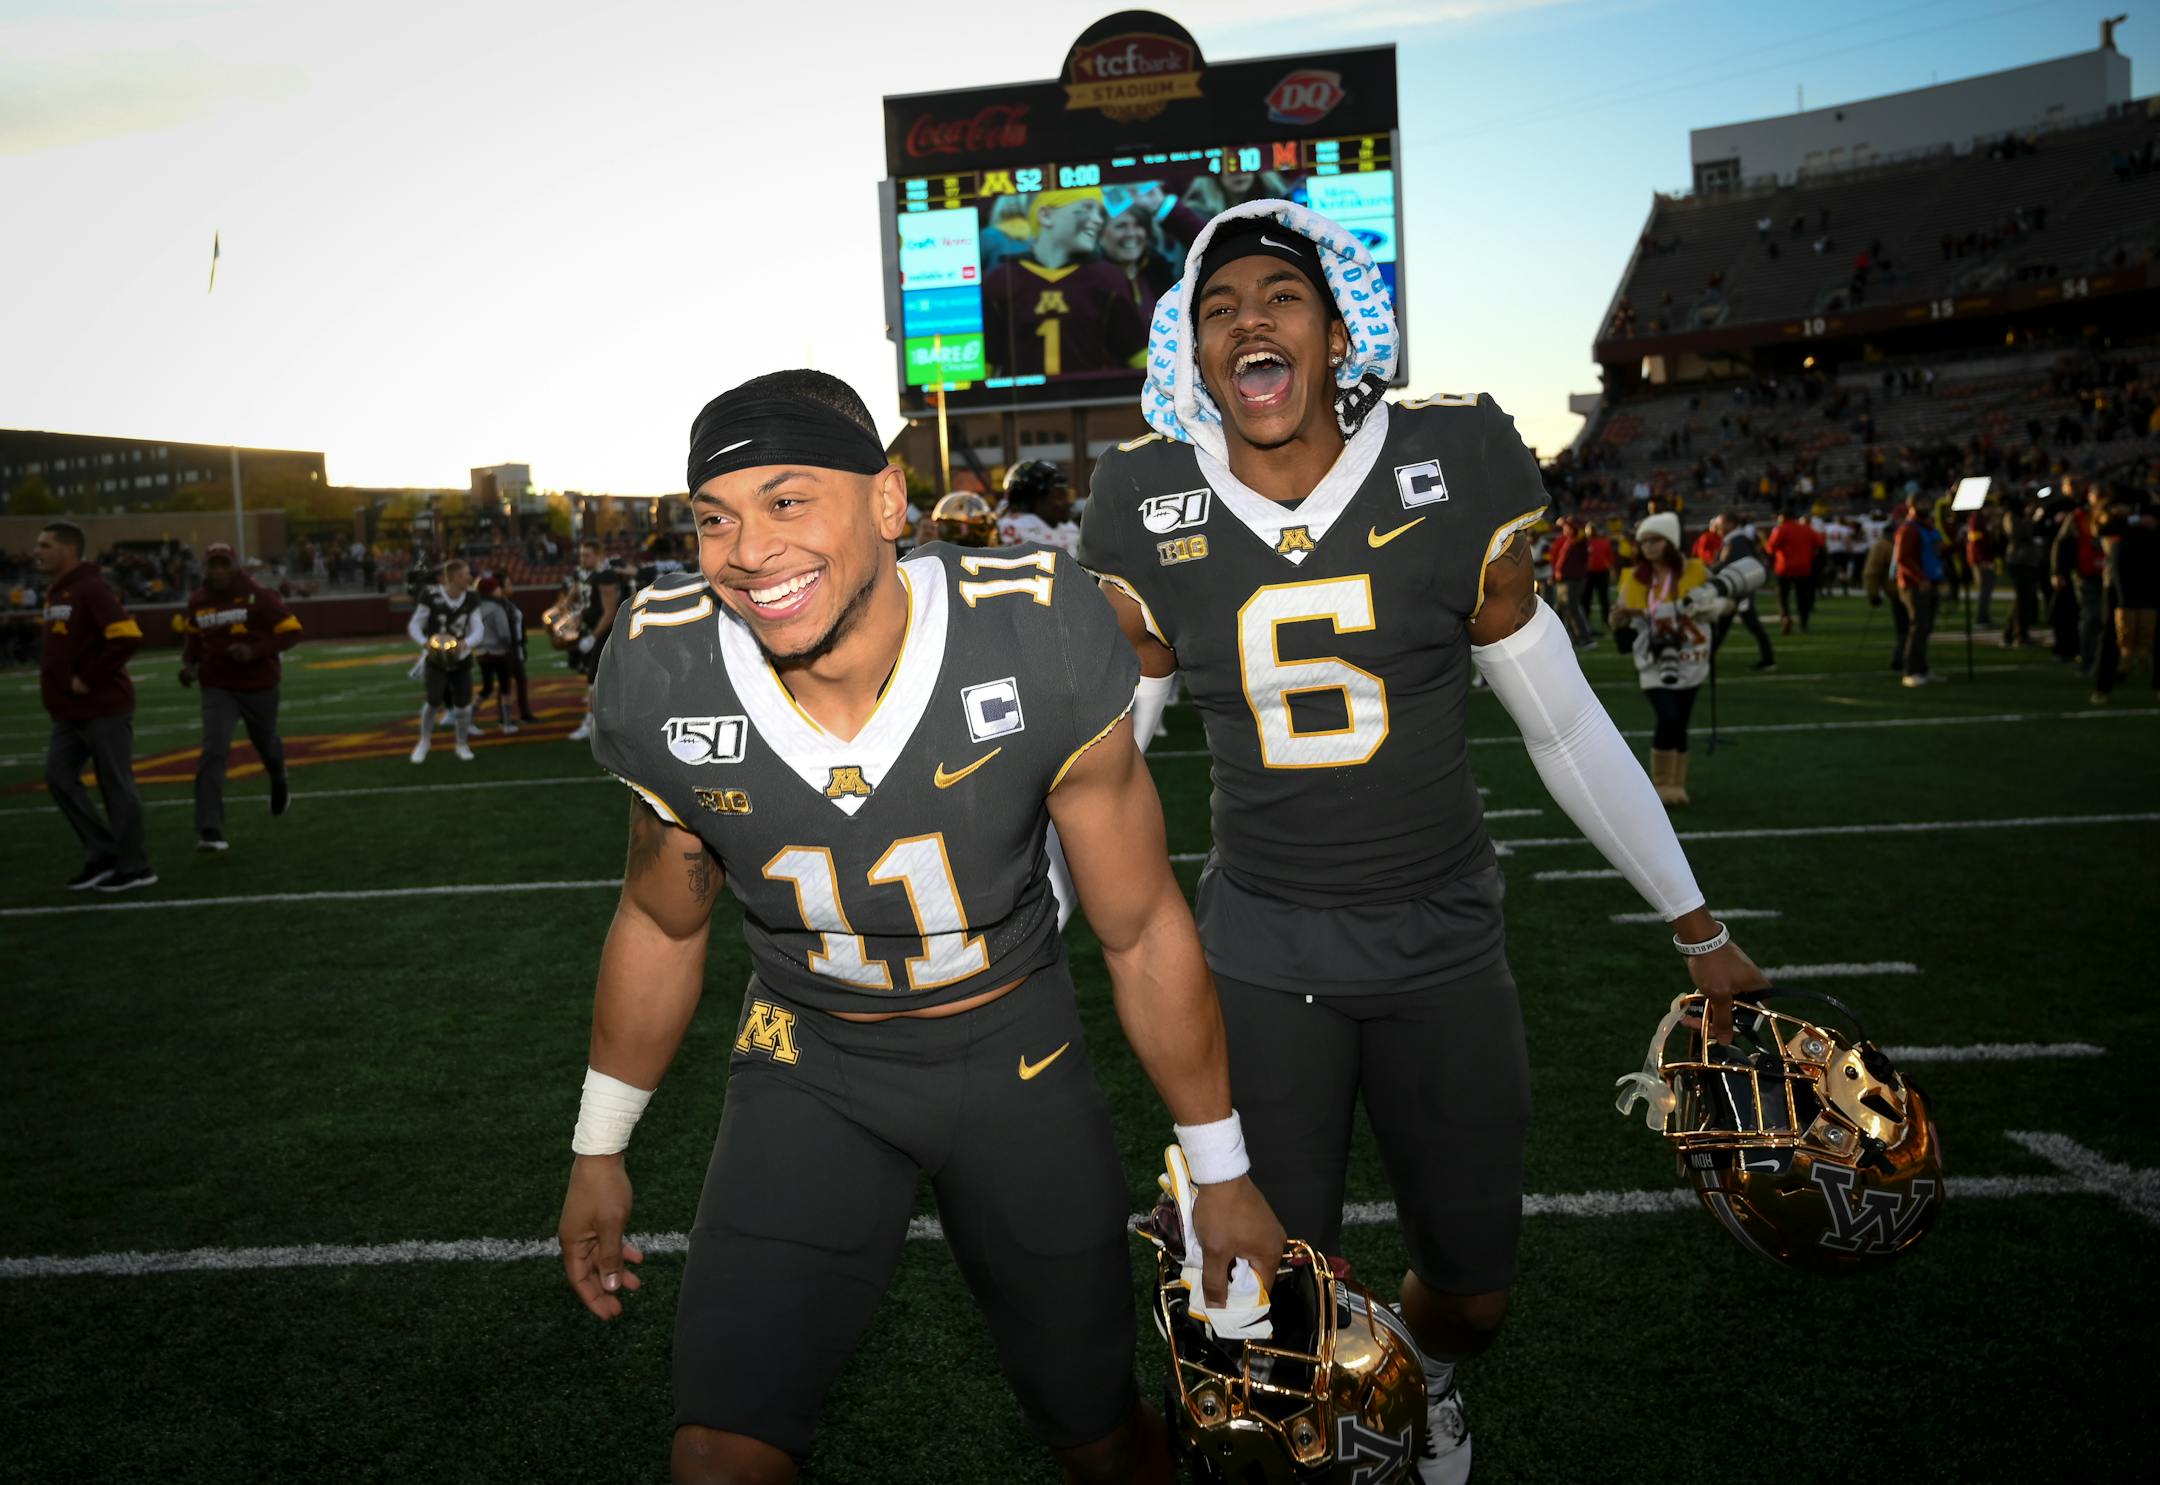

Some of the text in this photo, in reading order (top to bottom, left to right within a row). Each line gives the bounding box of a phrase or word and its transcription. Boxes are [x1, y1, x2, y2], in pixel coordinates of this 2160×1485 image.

[1093, 82, 1174, 101] STADIUM
[1280, 81, 1332, 112] DQ
[1014, 167, 1043, 193] 52
[1036, 318, 1062, 376] 1
[1803, 317, 1827, 336] 10
[1398, 461, 1446, 508] C
[1138, 487, 1212, 534] 150
[1275, 525, 1318, 555] M
[959, 549, 1058, 608] 11
[1237, 573, 1390, 770] 6
[965, 680, 1020, 740] C
[661, 715, 748, 765] 150
[823, 765, 874, 798] M
[762, 831, 991, 991] 11
[734, 999, 803, 1066] M
